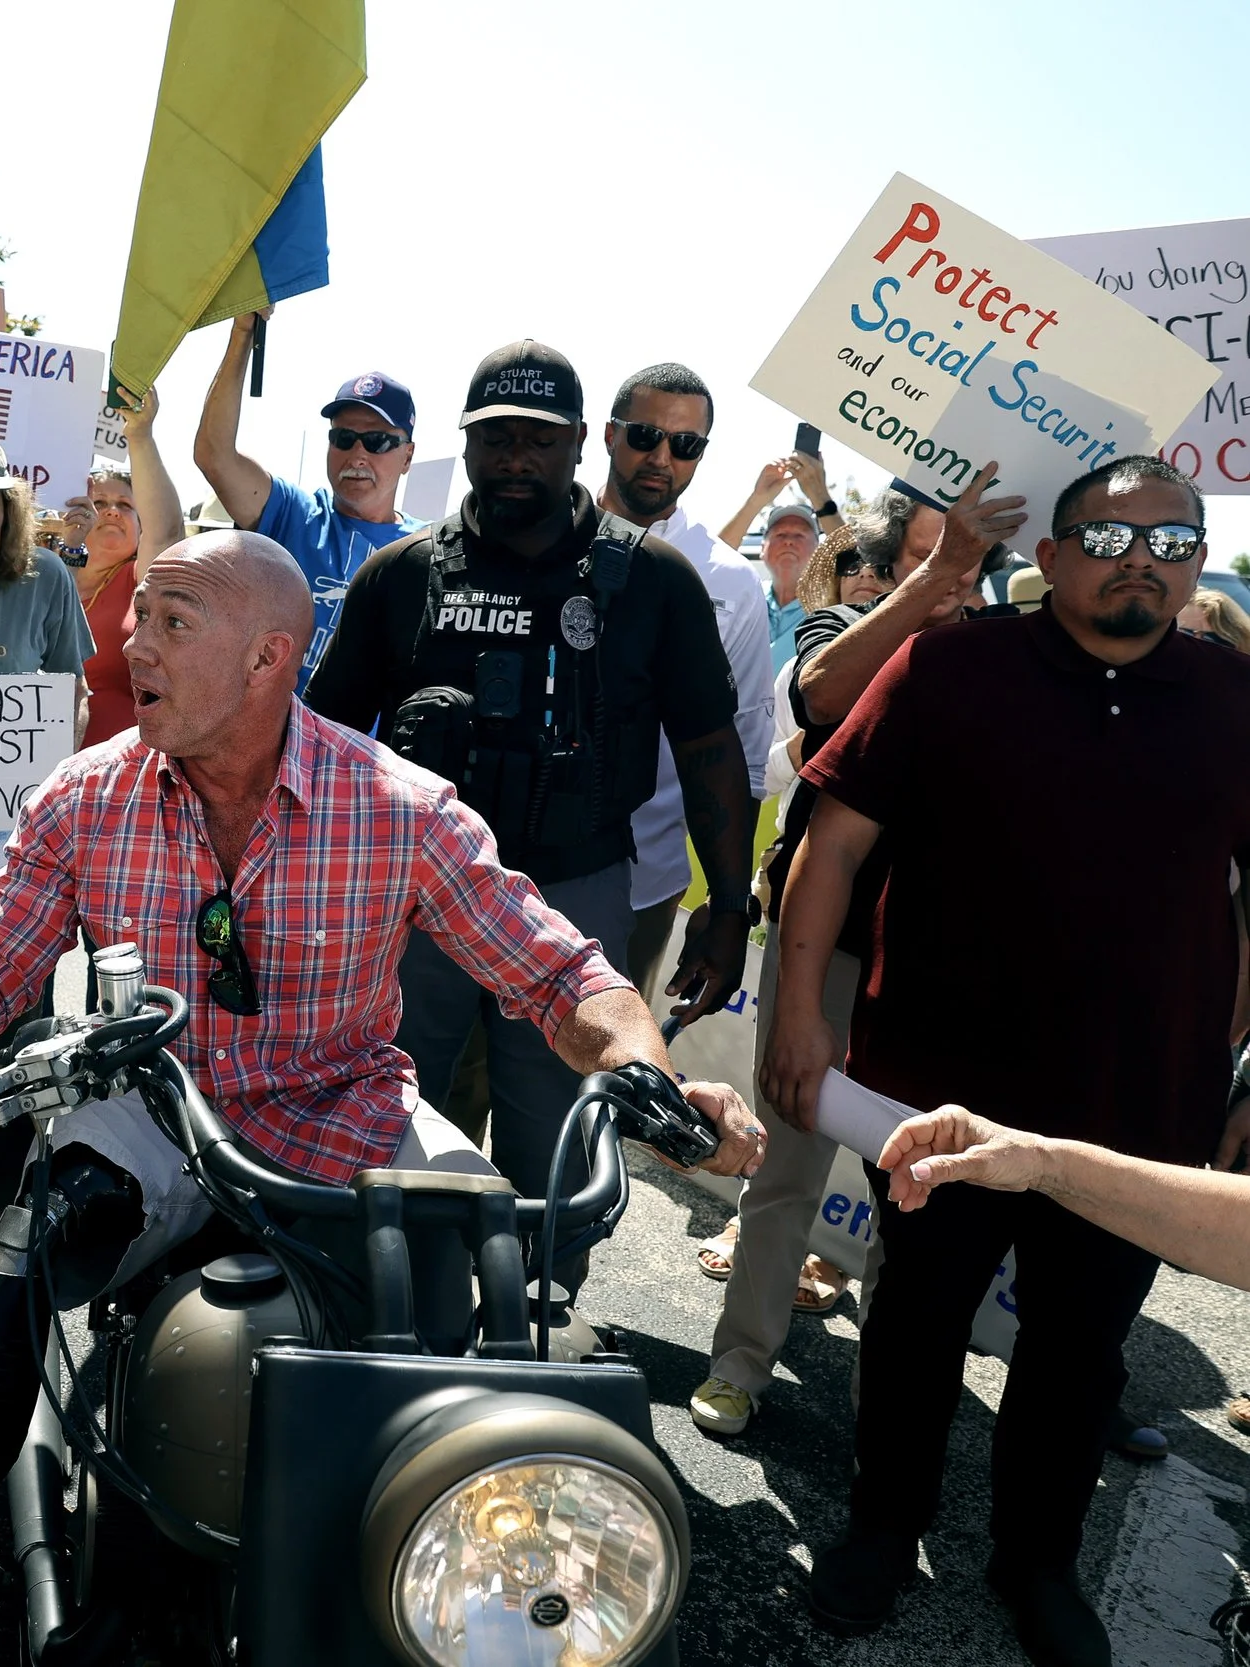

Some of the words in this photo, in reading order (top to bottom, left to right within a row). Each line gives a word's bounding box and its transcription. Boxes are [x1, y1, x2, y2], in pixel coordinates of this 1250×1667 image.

[872, 202, 1059, 350] Protect
[1148, 247, 1247, 304] doing
[483, 378, 555, 397] POLICE
[499, 369, 543, 379] STUART
[837, 346, 884, 378] and
[891, 376, 929, 402] our
[851, 276, 996, 387] Social
[988, 360, 1116, 472] Securit
[443, 592, 467, 603] OFC.
[471, 592, 521, 606] DELANCY
[436, 606, 533, 635] POLICE
